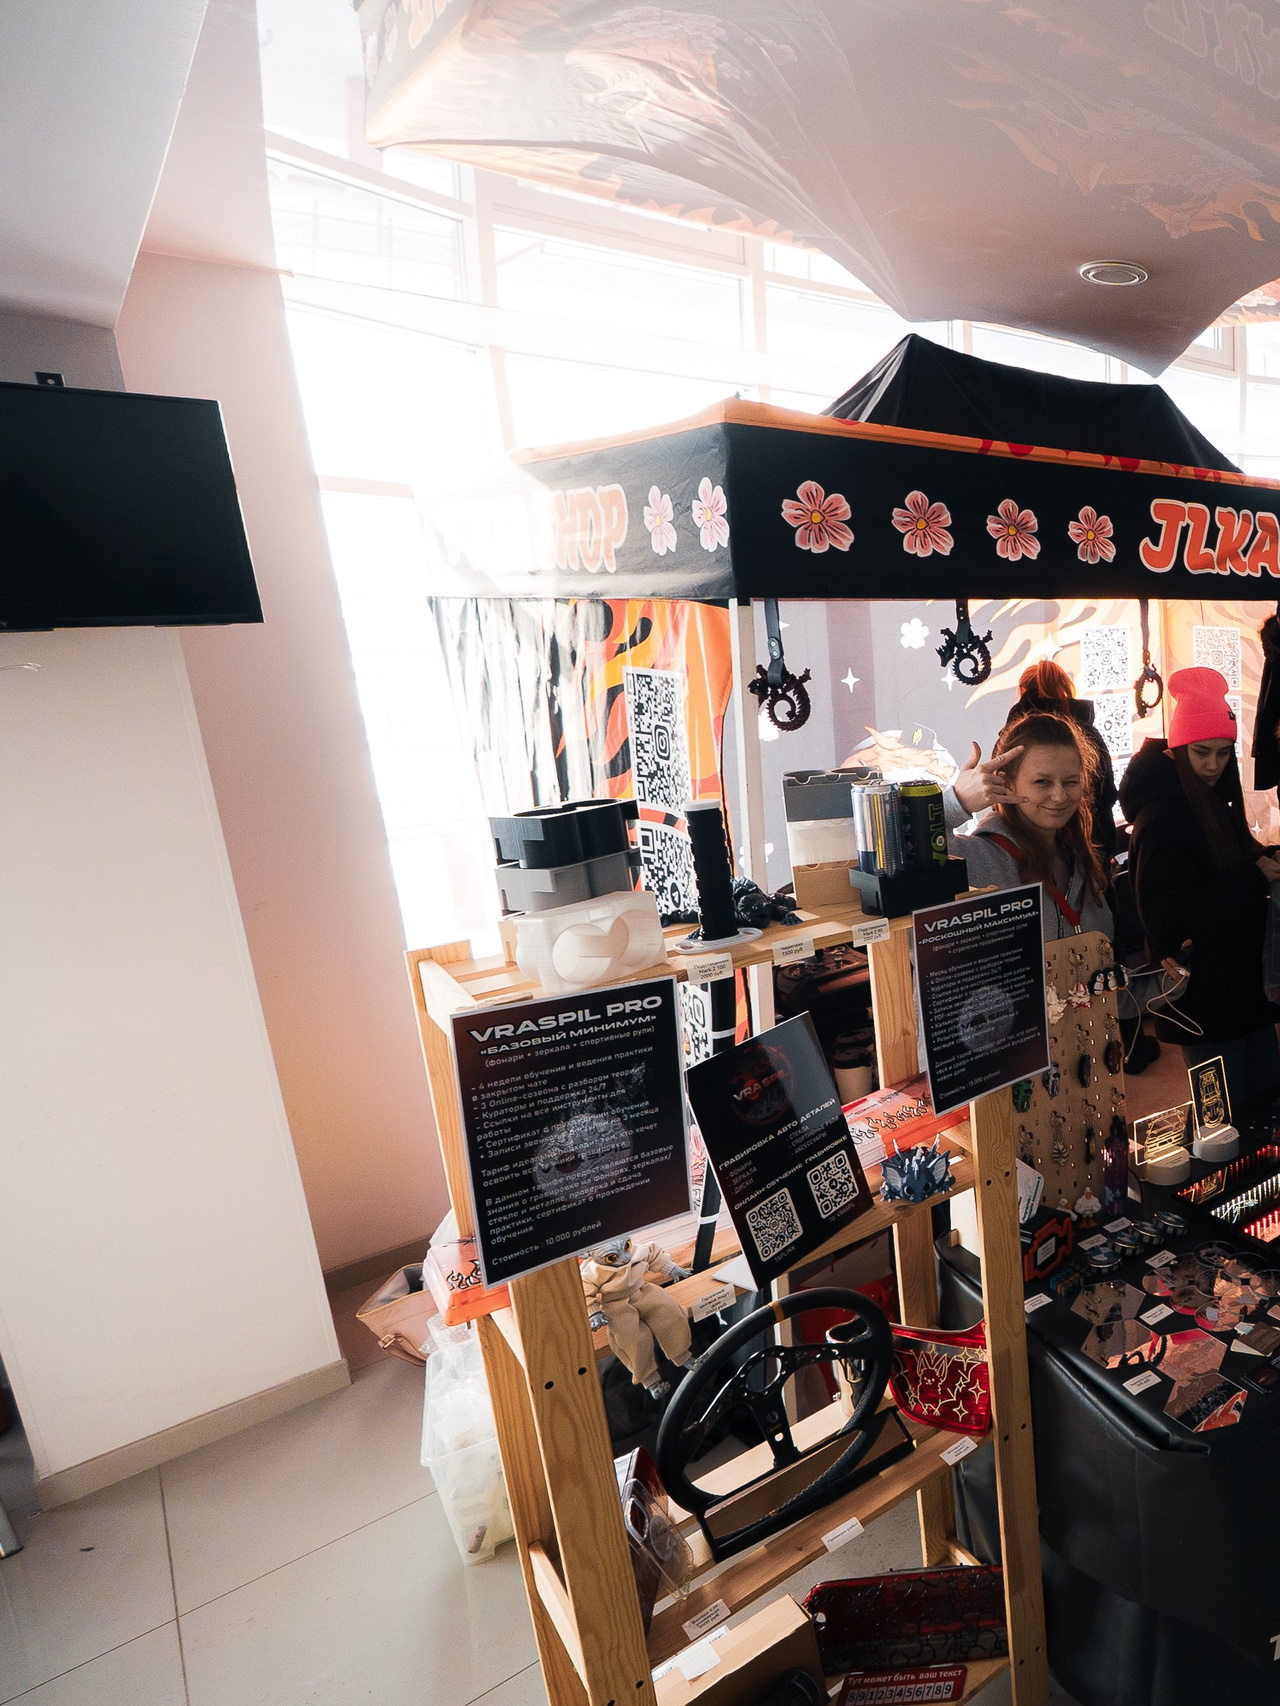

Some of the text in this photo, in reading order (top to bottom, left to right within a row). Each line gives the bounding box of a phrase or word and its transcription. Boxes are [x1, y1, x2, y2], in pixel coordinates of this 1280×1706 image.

[923, 897, 1032, 933] VRASPIL PRO
[469, 994, 662, 1044] VRASPIL PRO
[480, 1013, 656, 1056] «БАЗОВЫЙ МИНИМУМ»
[485, 1026, 654, 1068] (фонари зеркала спортивные рули)
[478, 1082, 484, 1090] 4
[487, 1075, 521, 1088] недели
[523, 1064, 565, 1080] обучения
[576, 1055, 612, 1068] ведения
[614, 1046, 652, 1060] практики
[480, 1084, 525, 1100] закрытом
[527, 1079, 547, 1088] чате
[482, 1102, 526, 1120] Кураторы
[537, 1089, 586, 1106] поддержка
[588, 1083, 606, 1092] 24/7
[476, 1126, 511, 1142] работы
[718, 1133, 774, 1171] ГРАВИРОВКА
[776, 1119, 798, 1136] АВТО
[799, 1096, 836, 1123] ДЕТАЛЕЙ
[804, 1134, 847, 1164] ГРАВИРОВКЕ
[489, 1216, 534, 1236] практики,
[536, 1198, 586, 1220] сертификат
[595, 1178, 650, 1201] прохождении
[490, 1225, 533, 1246] обучения
[491, 1220, 601, 1265] Стоимость 10.000 рублей
[863, 1675, 893, 1685] может
[893, 1672, 916, 1682] быть
[919, 1672, 937, 1680] ваш
[939, 1669, 963, 1678] текст
